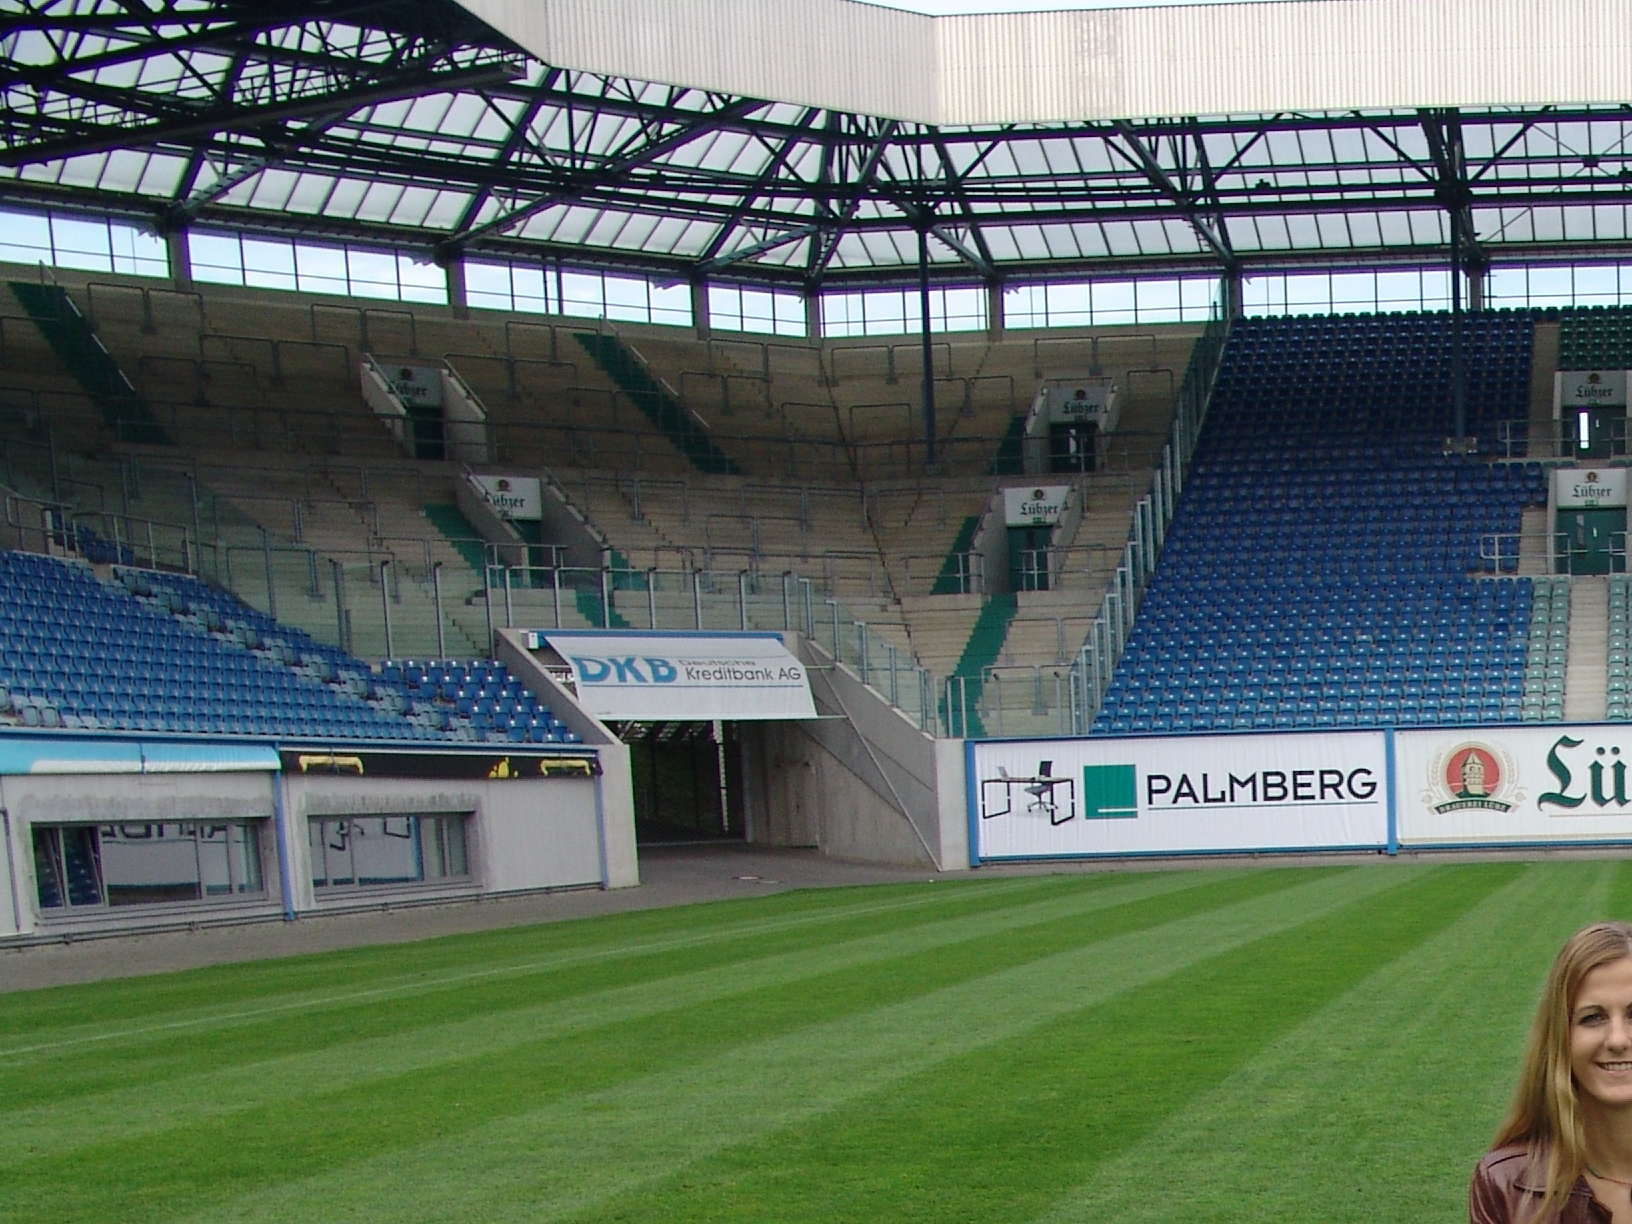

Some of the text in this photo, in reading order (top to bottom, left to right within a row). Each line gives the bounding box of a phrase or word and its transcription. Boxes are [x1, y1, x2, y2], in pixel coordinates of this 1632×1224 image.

[1572, 485, 1612, 498] Lübzer
[1020, 502, 1058, 515] Lübzer
[572, 657, 678, 683] DKB
[686, 667, 801, 681] Kreditbank AG
[1147, 768, 1378, 806] PALMBERG
